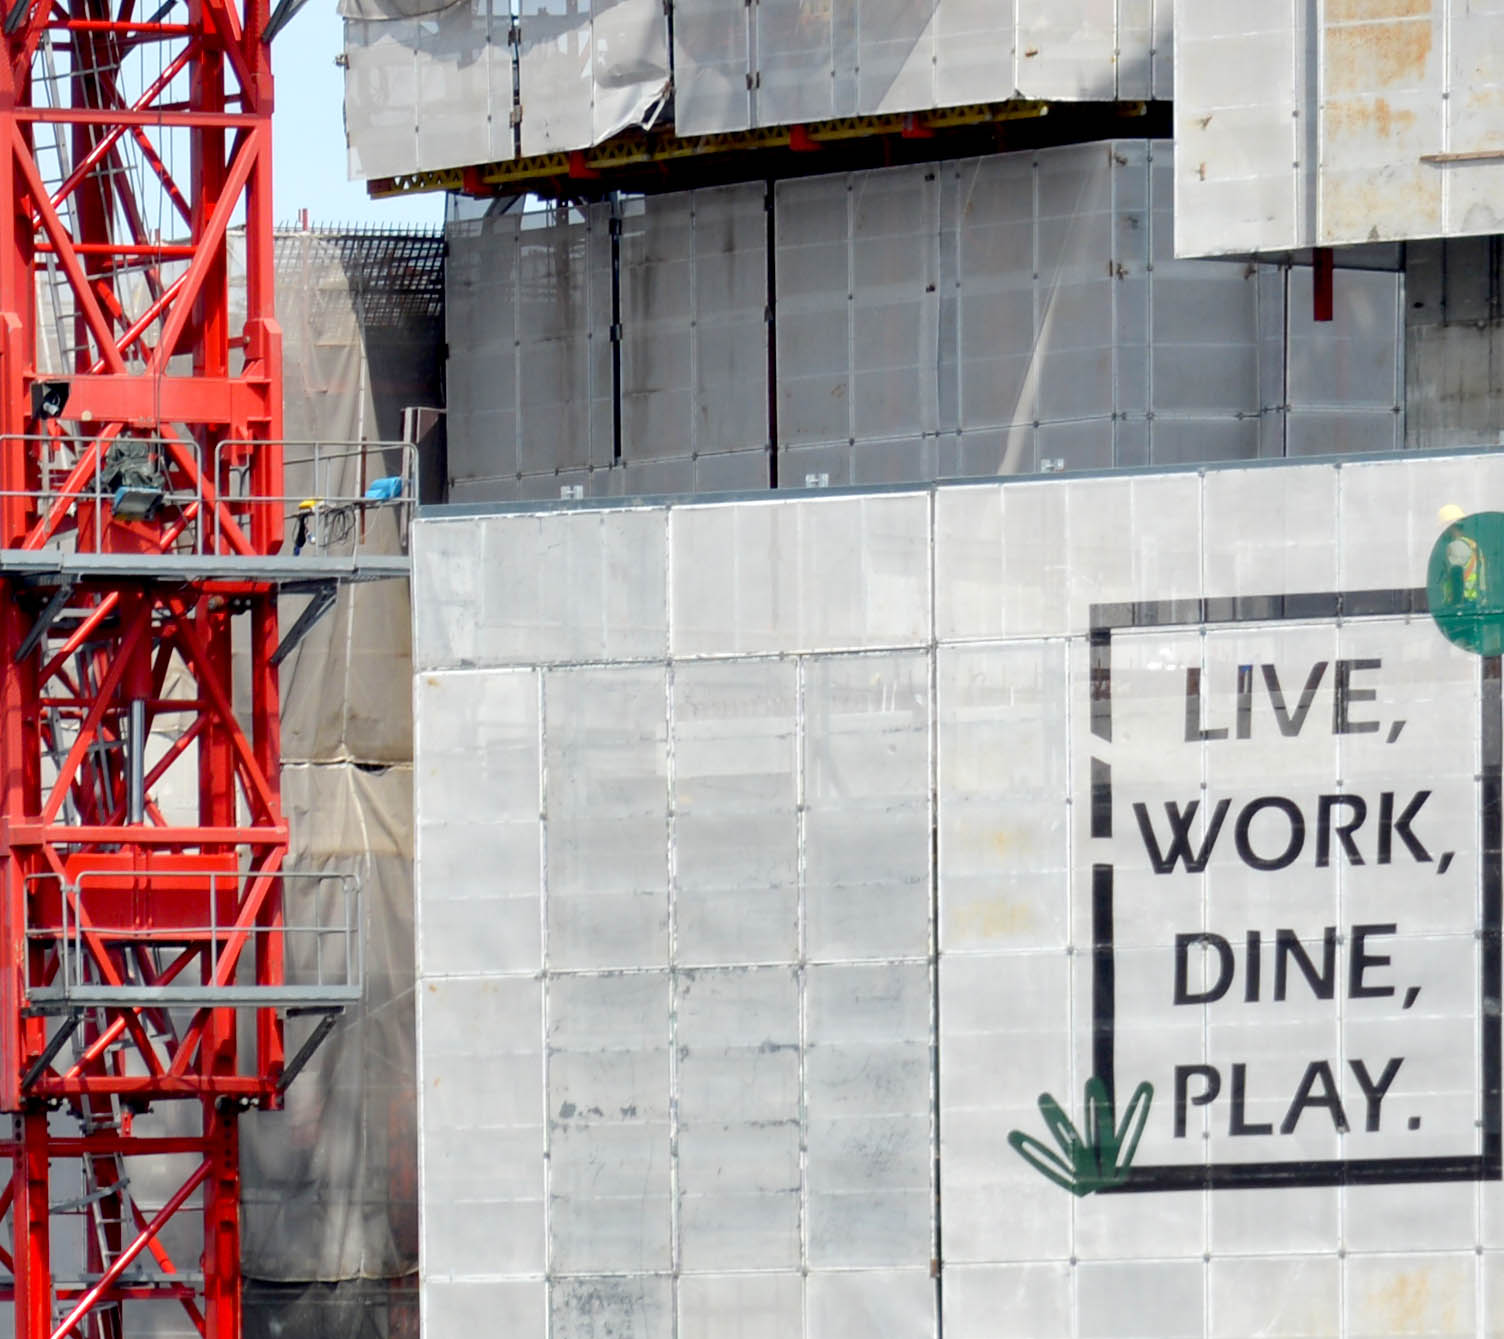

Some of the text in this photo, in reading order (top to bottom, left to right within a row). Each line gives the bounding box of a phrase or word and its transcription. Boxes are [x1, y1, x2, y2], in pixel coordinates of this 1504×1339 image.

[1184, 658, 1408, 744] LIVE,
[1133, 791, 1456, 876] WORK,
[1172, 923, 1423, 1010] DINE,
[1173, 1057, 1423, 1139] PLAY.
